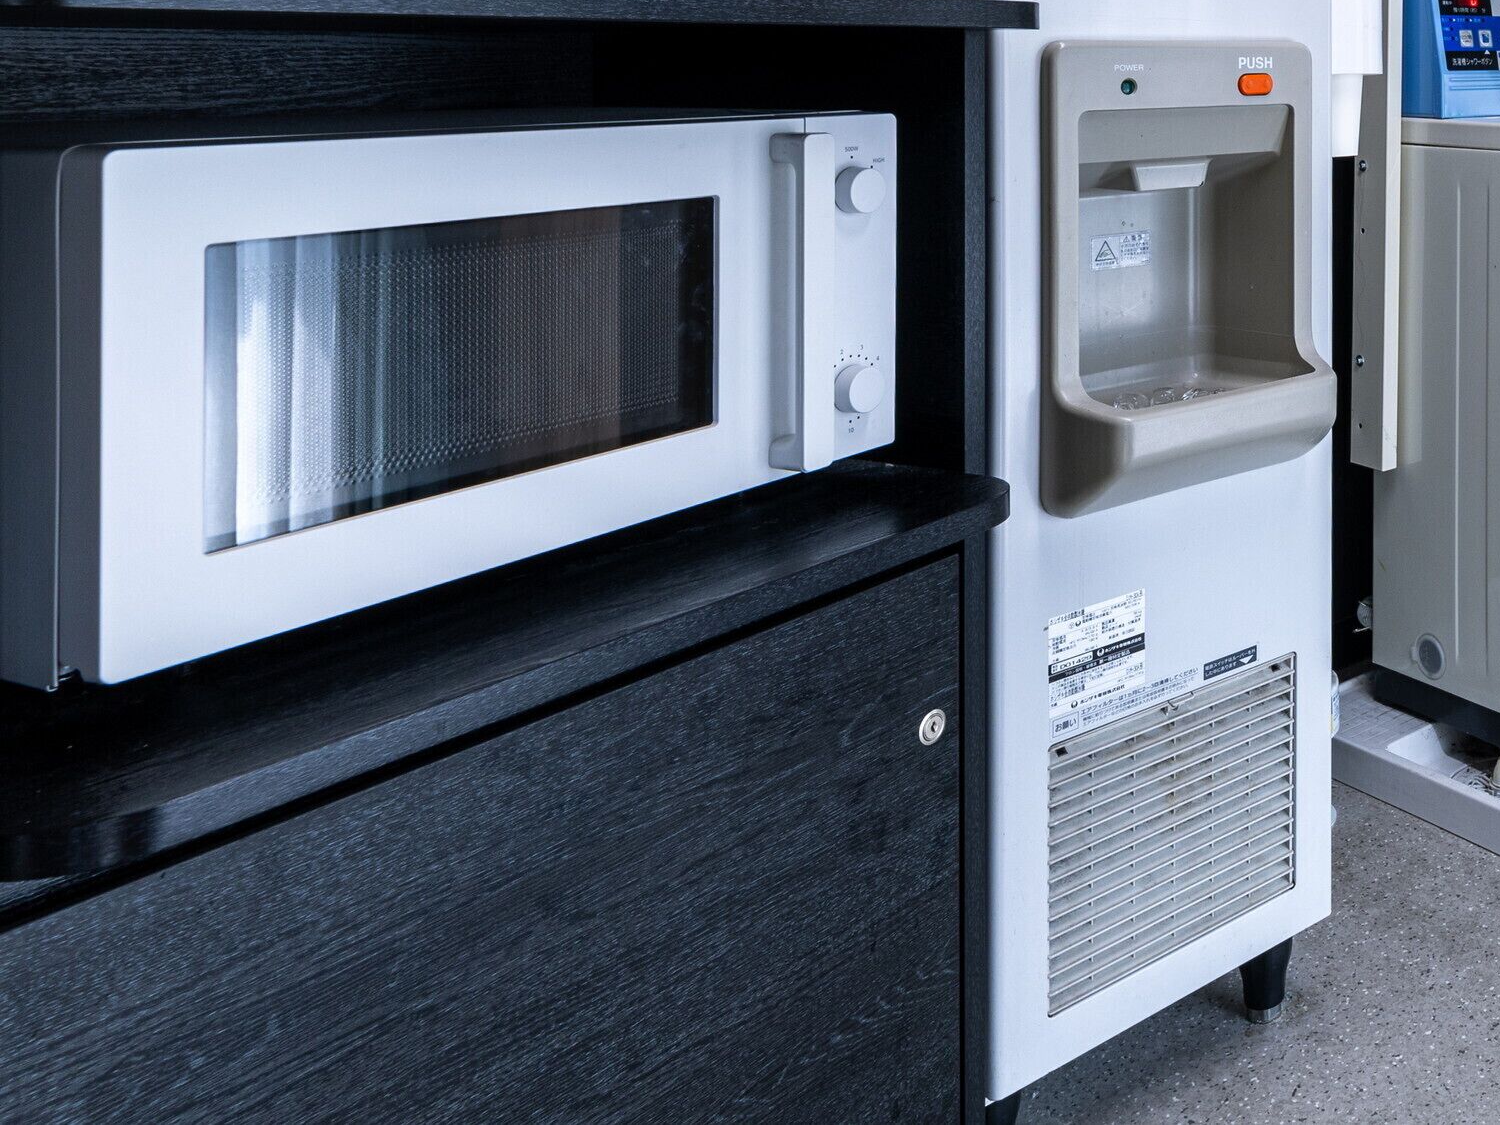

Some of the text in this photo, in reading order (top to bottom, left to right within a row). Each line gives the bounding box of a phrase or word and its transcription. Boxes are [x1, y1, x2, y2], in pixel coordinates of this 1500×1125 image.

[1114, 63, 1144, 72] POWER
[1238, 56, 1273, 69] PUSH
[1054, 717, 1077, 733] お願い
